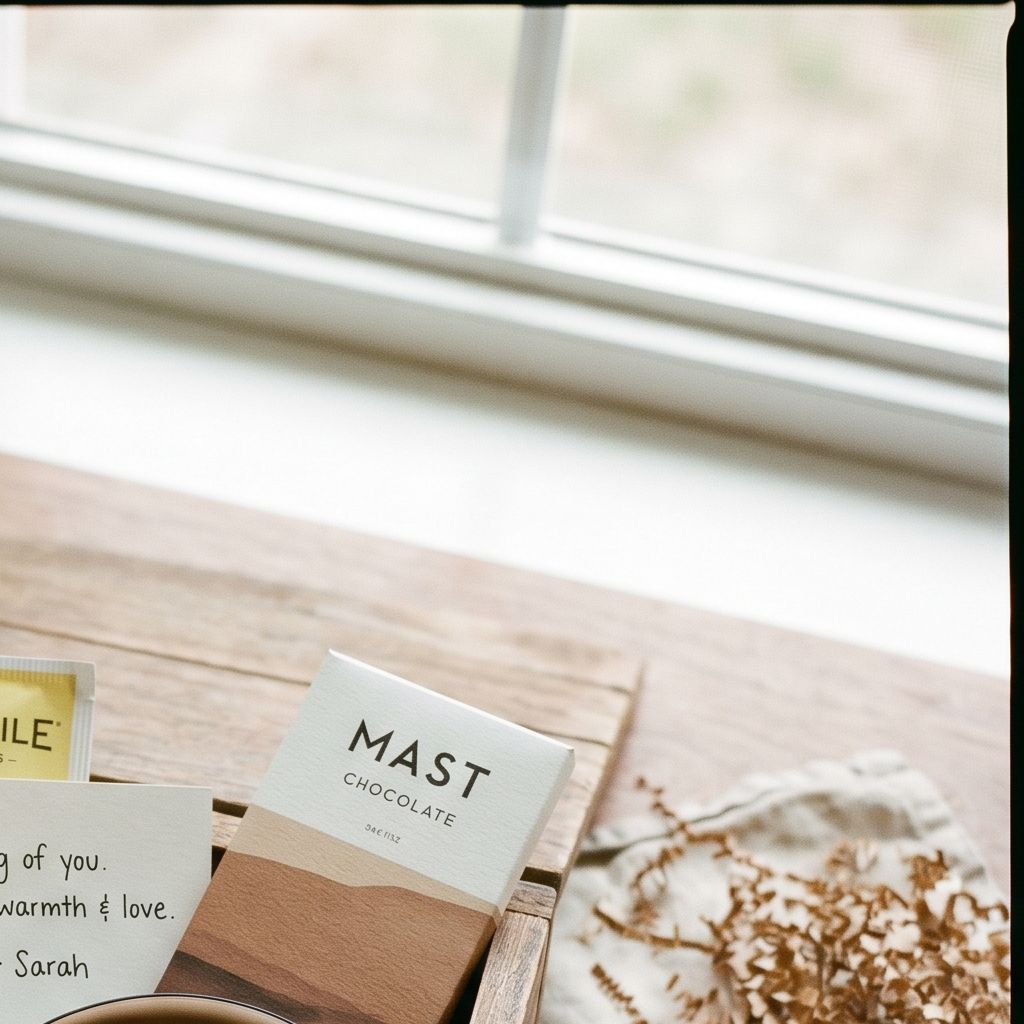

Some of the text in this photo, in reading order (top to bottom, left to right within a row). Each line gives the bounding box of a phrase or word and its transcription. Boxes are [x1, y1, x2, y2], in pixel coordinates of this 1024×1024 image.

[348, 718, 491, 799] MAST
[343, 771, 457, 828] CHOCOLATE
[22, 843, 47, 871] of
[60, 853, 107, 881] you.
[99, 894, 109, 922] &
[122, 895, 175, 920] love.
[14, 949, 89, 979] Sarah
